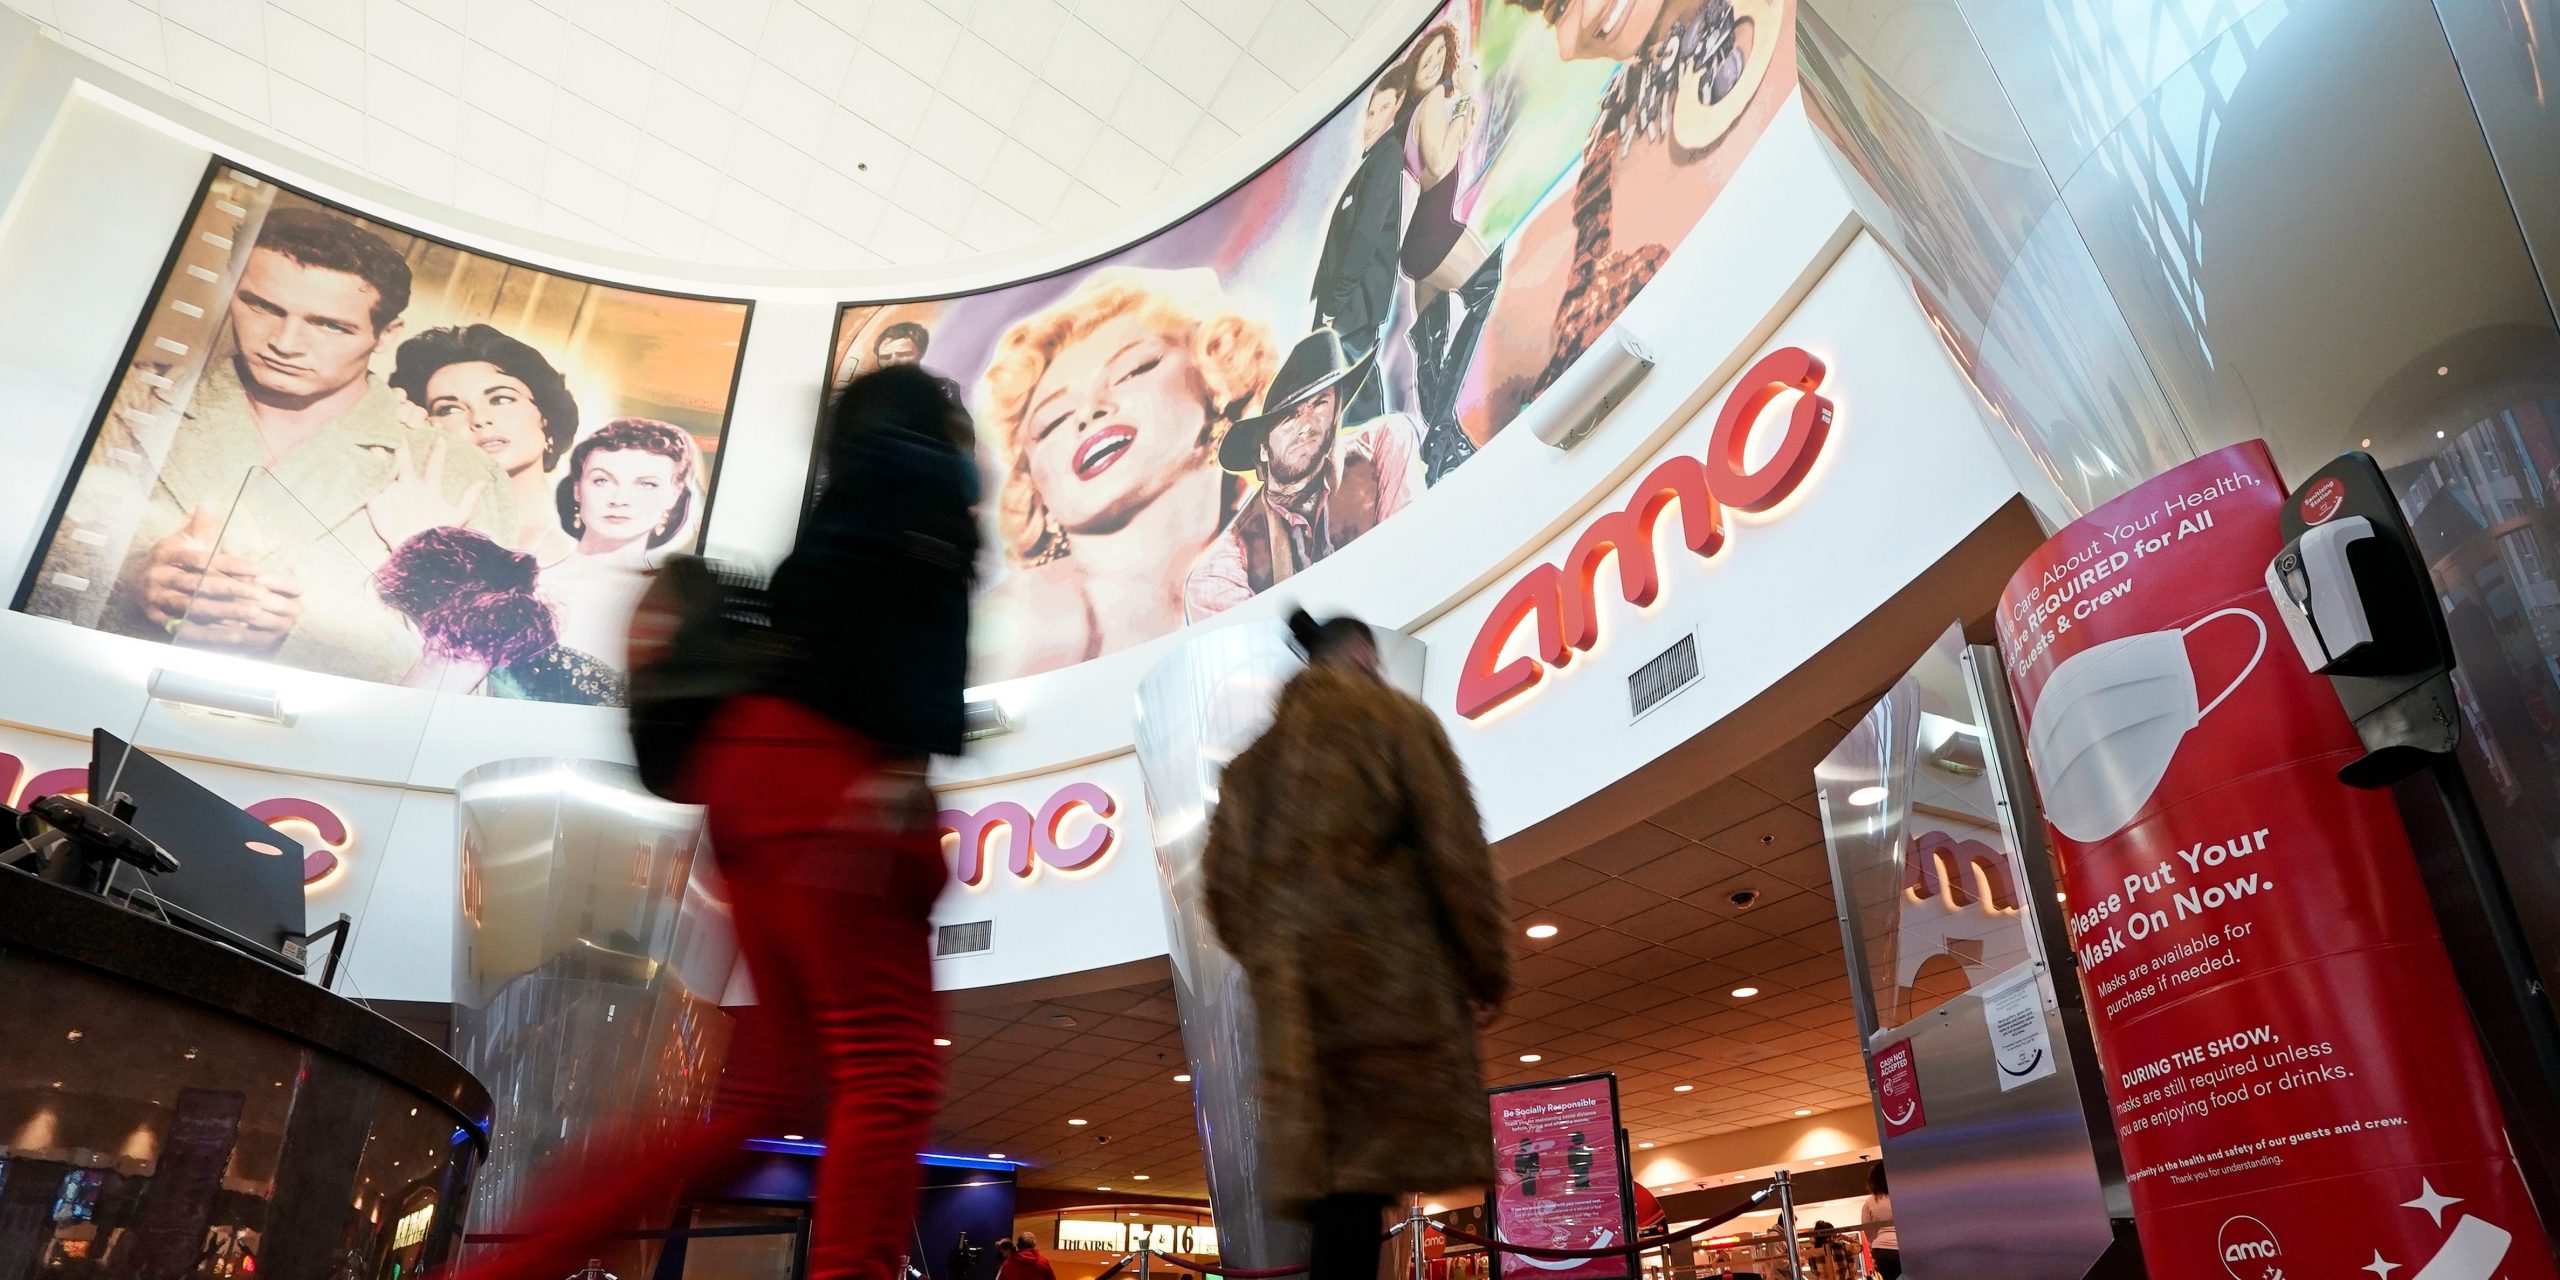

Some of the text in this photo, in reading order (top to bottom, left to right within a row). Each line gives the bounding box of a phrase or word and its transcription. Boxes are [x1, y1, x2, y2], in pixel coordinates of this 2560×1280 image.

[2304, 481, 2334, 505] Sanitizing
[2310, 489, 2332, 508] Station
[1456, 346, 1835, 720] amc
[2013, 587, 2040, 621] Care
[2042, 540, 2102, 591] About
[2103, 511, 2159, 545] Your
[2165, 471, 2261, 517] Health,
[2013, 629, 2029, 658] Are
[2028, 551, 2129, 633] REQUIRED
[2134, 532, 2172, 559] for
[2177, 509, 2214, 541] All
[2019, 629, 2056, 678] Guests
[2057, 614, 2072, 634] &
[2073, 578, 2132, 620] Crew
[2070, 828, 2270, 937] Please Put Your
[2079, 872, 2274, 974] Mask On Now.
[2097, 922, 2252, 998] Masks are available for
[2106, 949, 2241, 1020] purchase if needed.
[1880, 1050, 1906, 1069] CASH NOT
[1881, 1058, 1908, 1077] ACCEPTED
[2116, 1042, 2333, 1116] masks are still required unless
[2121, 1025, 2280, 1089] DURING THE SHOW,
[1503, 1098, 1597, 1118] Be Socially Responsible
[2119, 1064, 2354, 1141] you are enjoying food or drinks.
[2136, 1167, 2157, 1181] priority
[2156, 1163, 2165, 1172] is
[2165, 1161, 2179, 1171] the
[2179, 1154, 2206, 1168] health
[2207, 1149, 2224, 1162] and
[2225, 1143, 2253, 1157] safety
[2255, 1139, 2266, 1150] of
[2268, 1136, 2287, 1147] our
[2289, 1127, 2332, 1145] guests
[2334, 1120, 2361, 1134] and
[2364, 1117, 2408, 1129] crew.
[2170, 1155, 2284, 1184] Thank you for understanding.
[1063, 1239, 1113, 1252] THEATRES
[1182, 1226, 1194, 1253] 6
[1425, 1236, 1445, 1247] amc
[2225, 1239, 2276, 1262] amc
